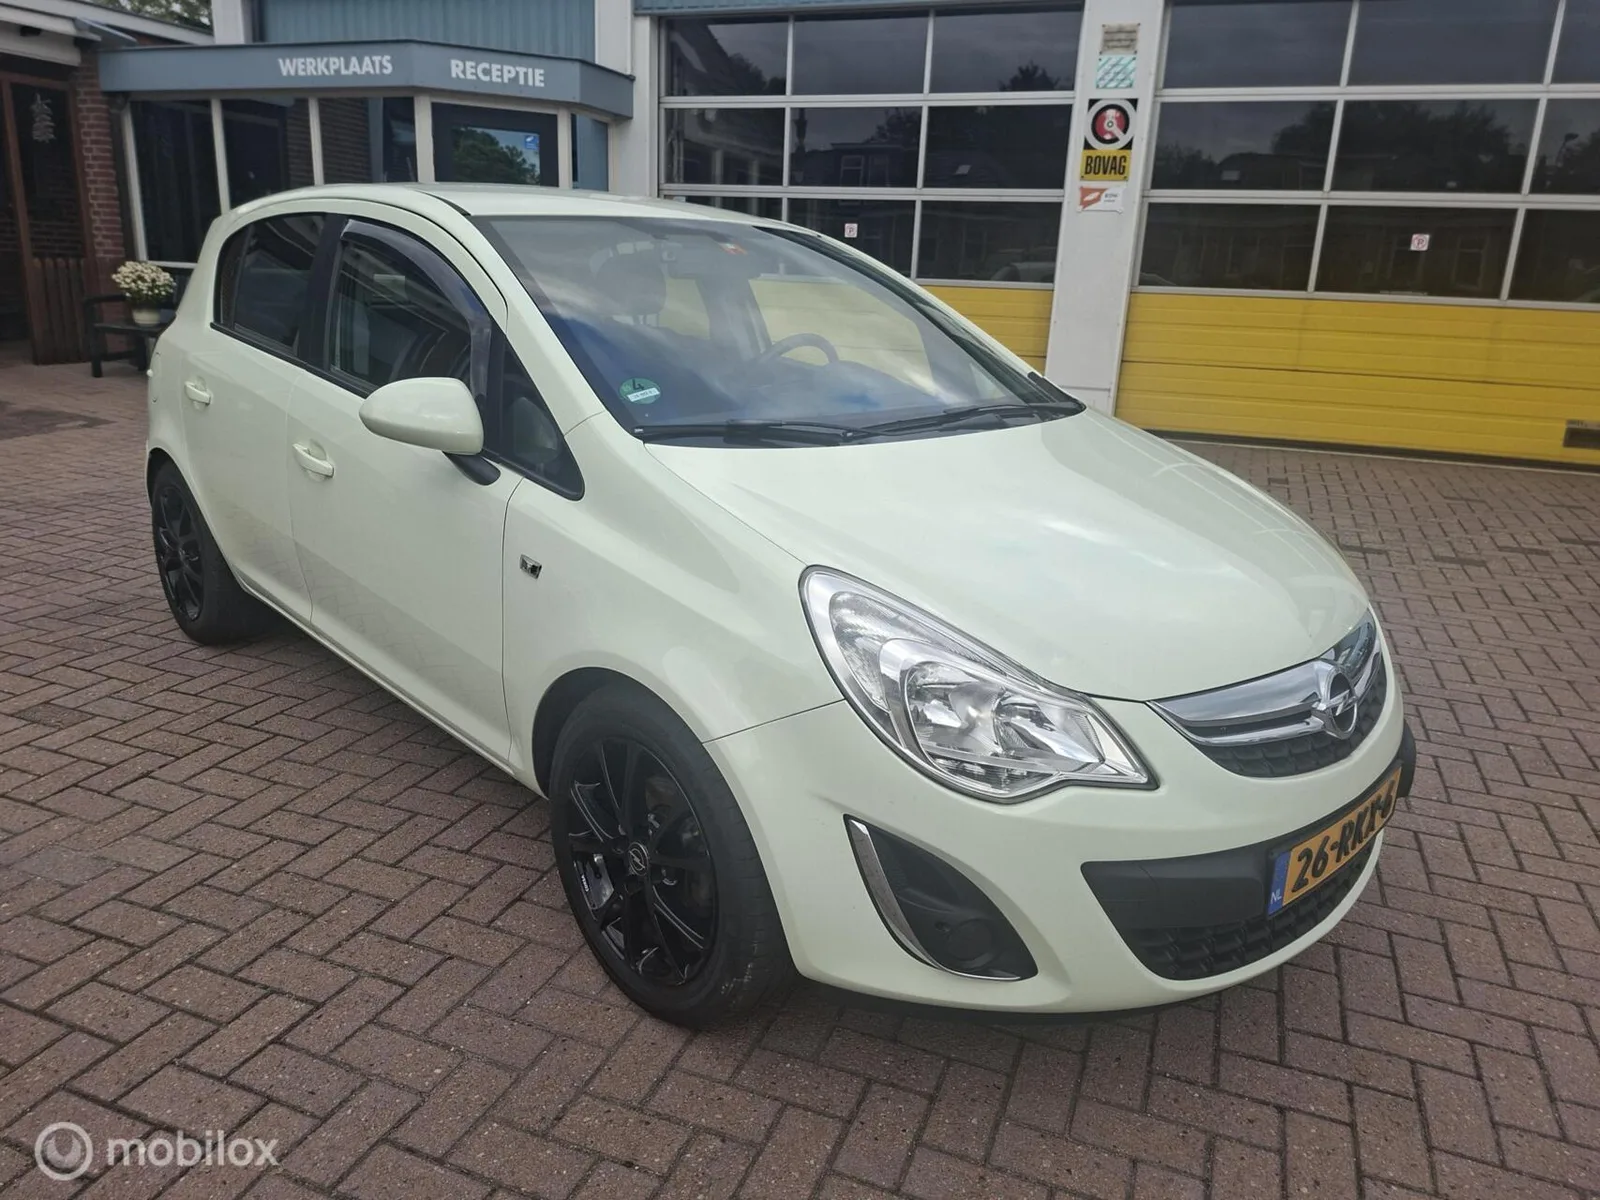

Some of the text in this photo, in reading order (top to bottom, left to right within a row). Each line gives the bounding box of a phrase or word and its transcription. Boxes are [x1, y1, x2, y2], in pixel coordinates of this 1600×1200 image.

[278, 55, 393, 76] WERKPLAATS
[450, 59, 545, 87] RECEPTIE
[1085, 155, 1127, 175] BOVAG
[1271, 890, 1282, 903] NL
